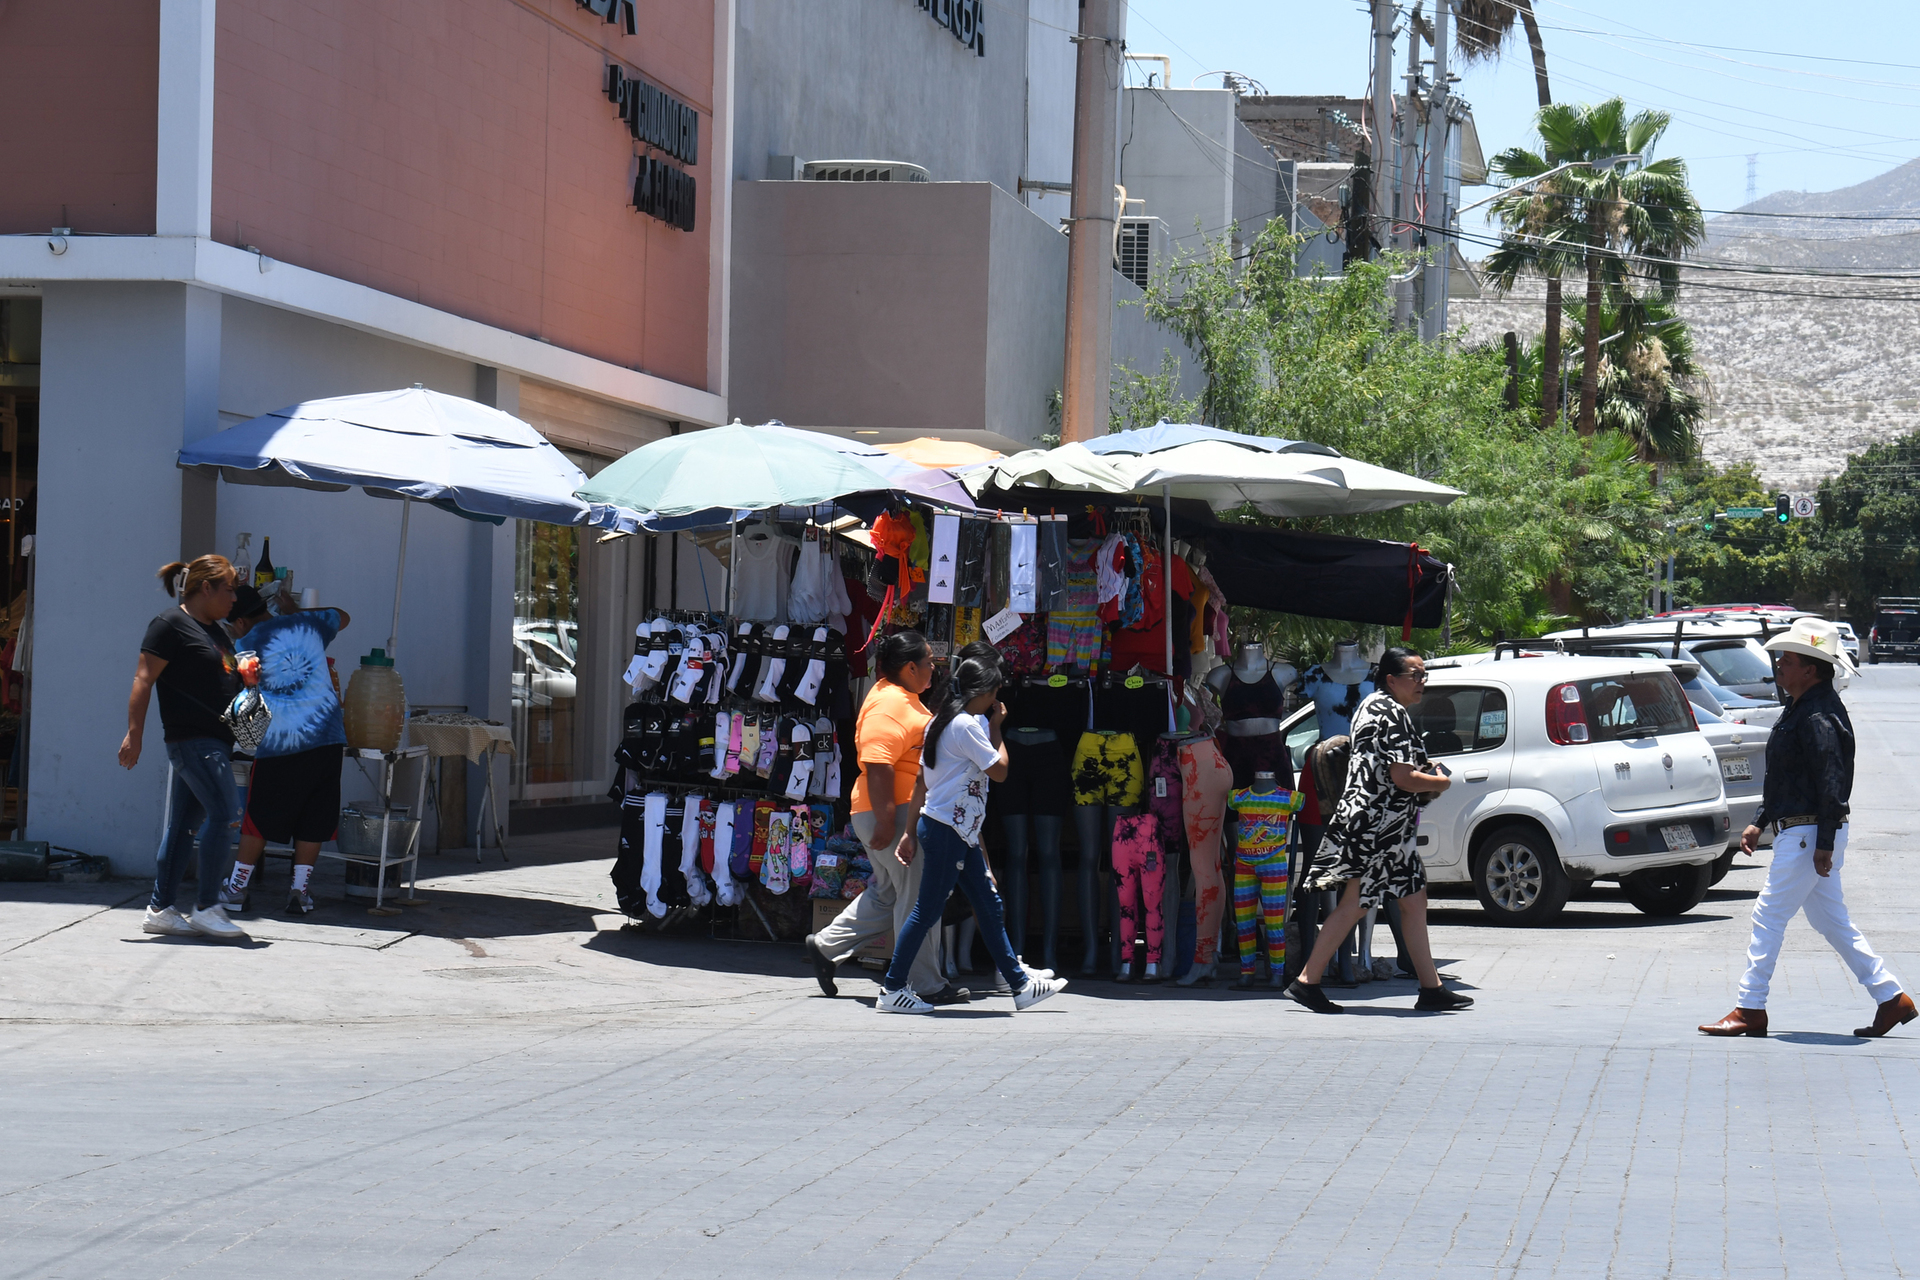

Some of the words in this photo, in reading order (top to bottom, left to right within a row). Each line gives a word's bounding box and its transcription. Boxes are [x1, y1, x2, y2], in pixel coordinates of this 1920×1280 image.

[610, 65, 634, 118] By
[632, 80, 680, 159] CUIDADO
[680, 104, 698, 165] CON
